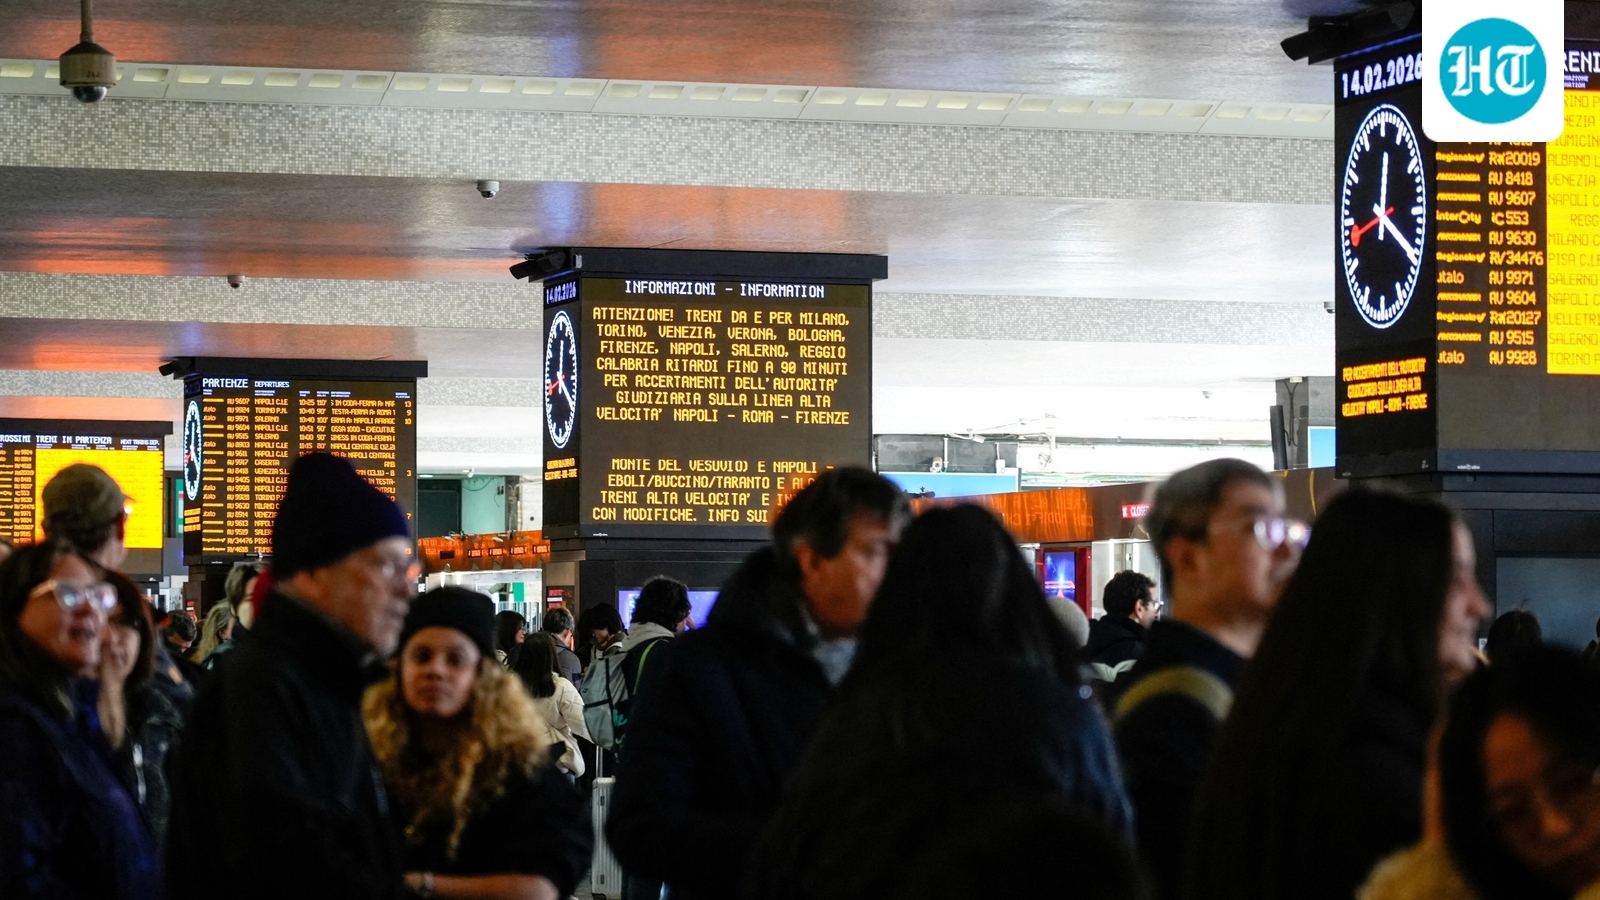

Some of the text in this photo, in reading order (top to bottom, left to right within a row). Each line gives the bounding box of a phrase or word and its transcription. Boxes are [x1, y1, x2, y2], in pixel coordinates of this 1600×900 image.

[1342, 52, 1422, 98] 14.02.2026
[1548, 154, 1590, 167] ALBANO
[1505, 170, 1534, 186] 8418
[1548, 174, 1596, 187] VENEZIA
[1506, 190, 1536, 206] 9607
[1548, 194, 1588, 206] NAPOLI
[1506, 210, 1529, 226] 553
[1506, 230, 1536, 246] 9630
[1548, 253, 1576, 267] PISA
[1506, 270, 1534, 286] 9971
[1549, 273, 1598, 287] SALERNO
[626, 281, 715, 295] INFORMAZIONI
[741, 284, 824, 298] INFORMATION
[1506, 290, 1536, 306] 9604
[1548, 293, 1588, 306] NAPOLI
[593, 307, 849, 325] ATTENZIONE! TRENI DA E PER MILANO,
[597, 324, 845, 342] TORINO, VENEZIA, VERONA, BOLOGNA,
[1506, 330, 1534, 346] 9515
[1549, 333, 1598, 346] SALERNO
[601, 341, 845, 358] FIRENZE, NAPOLI, SALERNO, REGGIO
[597, 357, 847, 375] CALABRIA RITARDI FINO A 90 MINUTI
[1506, 350, 1538, 366] 9928
[1550, 353, 1590, 366] TORINO
[203, 378, 248, 388] PARTENZE
[605, 374, 837, 391] PER ACCERTAMENTI DELL'AUTORITA'
[616, 391, 830, 407] GIUDIZIARIA SULLA LINEA ALTA
[597, 407, 662, 420] VELOCITA'
[674, 409, 718, 422] NAPOLI
[743, 410, 773, 423] ROMA
[796, 411, 849, 424] FIRENZE
[75, 436, 113, 444] PARTENZA
[612, 459, 650, 470] MONTE
[658, 459, 681, 471] DEL
[689, 460, 748, 472] VESUVIO)
[758, 461, 766, 472] E
[773, 462, 817, 473] NAPOLI
[608, 474, 786, 490] EBOLI/BUCCINO/TARANTO E
[601, 491, 637, 504] TRENI
[647, 492, 678, 504] ALTA
[685, 492, 750, 505] VELOCITA'
[762, 493, 770, 506] E
[593, 507, 770, 522] CON MODIFICHE. INFO SUI
